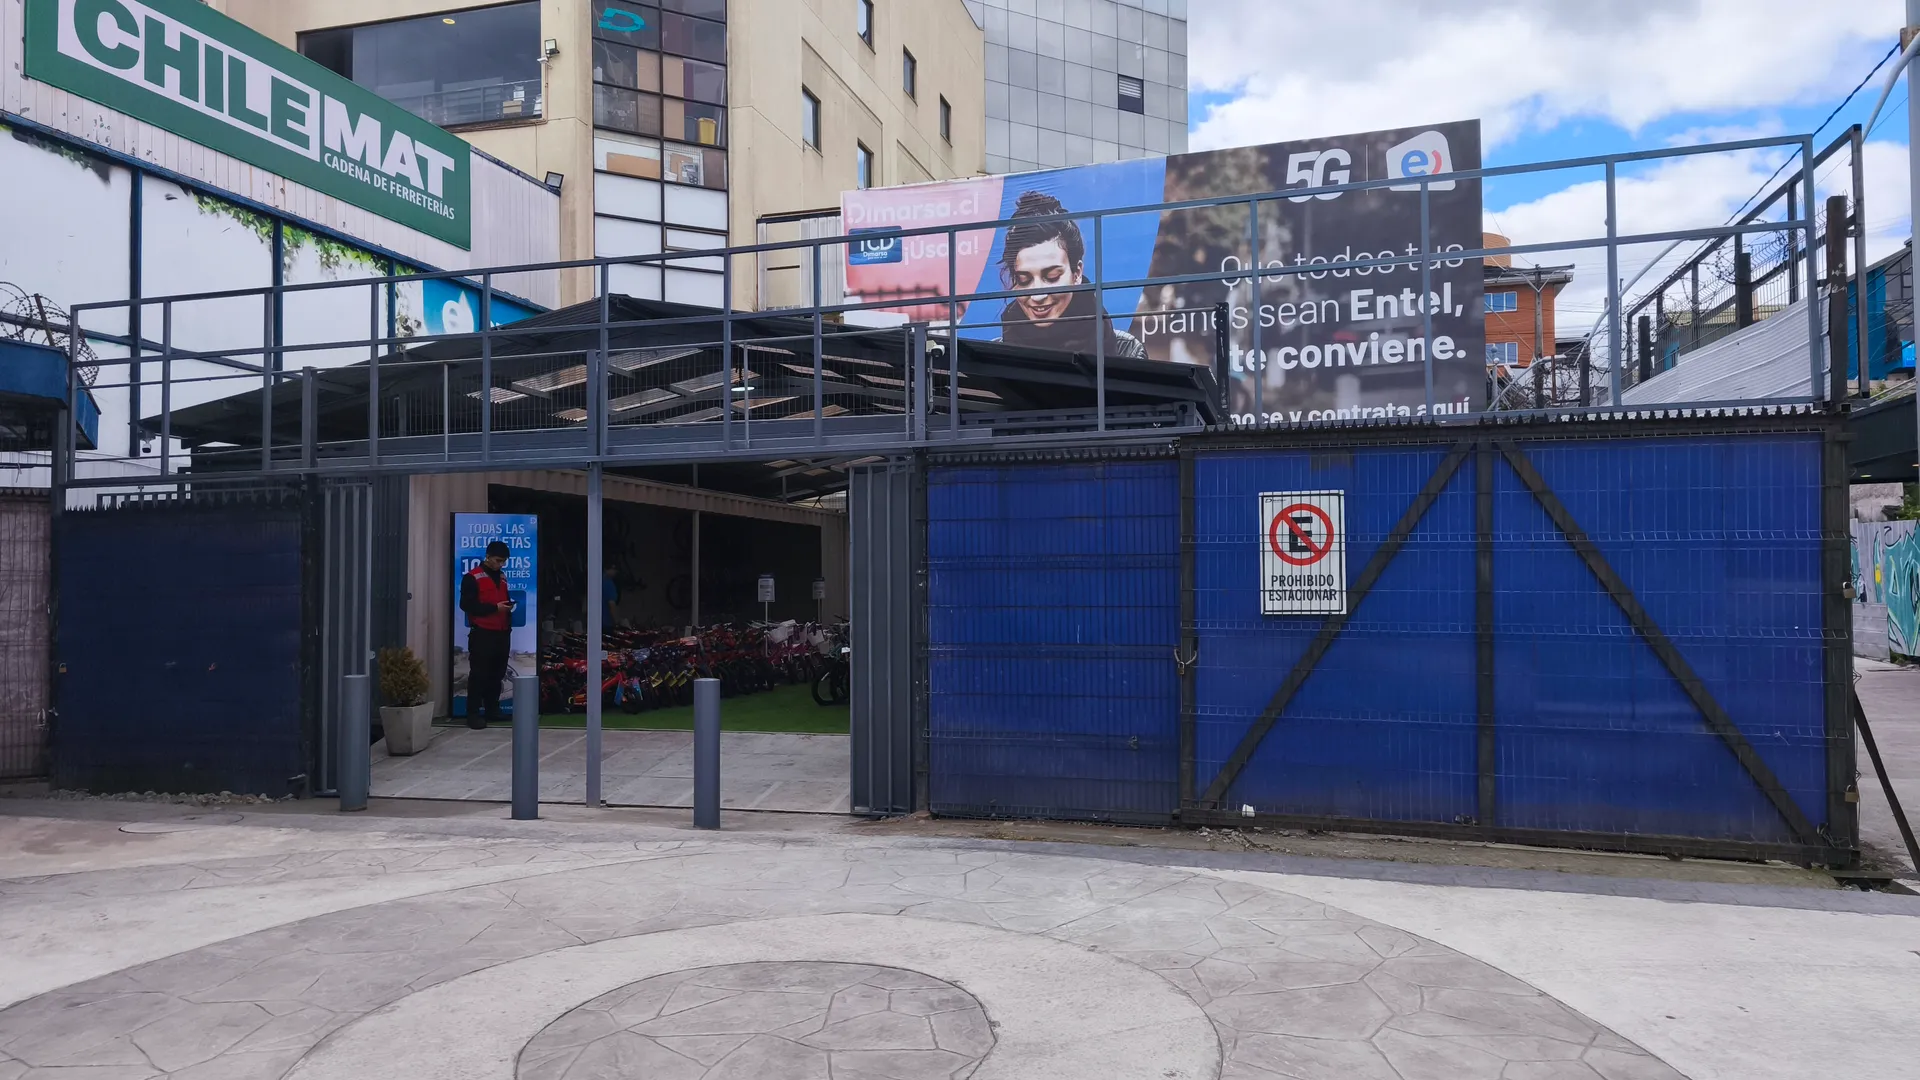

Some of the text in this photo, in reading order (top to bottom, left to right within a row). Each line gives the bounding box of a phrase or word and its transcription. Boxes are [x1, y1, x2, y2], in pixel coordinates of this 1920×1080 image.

[73, 0, 455, 199] CHILEMAT
[324, 153, 455, 220] CADENA DE FERRETERÍAS
[1285, 148, 1352, 203] 5G
[847, 192, 979, 224] Dimarsa.cl
[904, 235, 979, 266] ¡Úsaa!
[1294, 245, 1395, 280] todos
[1259, 299, 1340, 328] sean
[1350, 282, 1464, 321] Entel,
[1230, 331, 1467, 372] te conviene.
[1308, 402, 1411, 422] contrata
[461, 536, 532, 549] BICICETAS
[468, 523, 525, 534] TODAS LAS
[502, 568, 531, 578] NTERÉS
[1271, 574, 1335, 588] PROHIBIDO
[1268, 588, 1337, 602] ESTACIONAR
